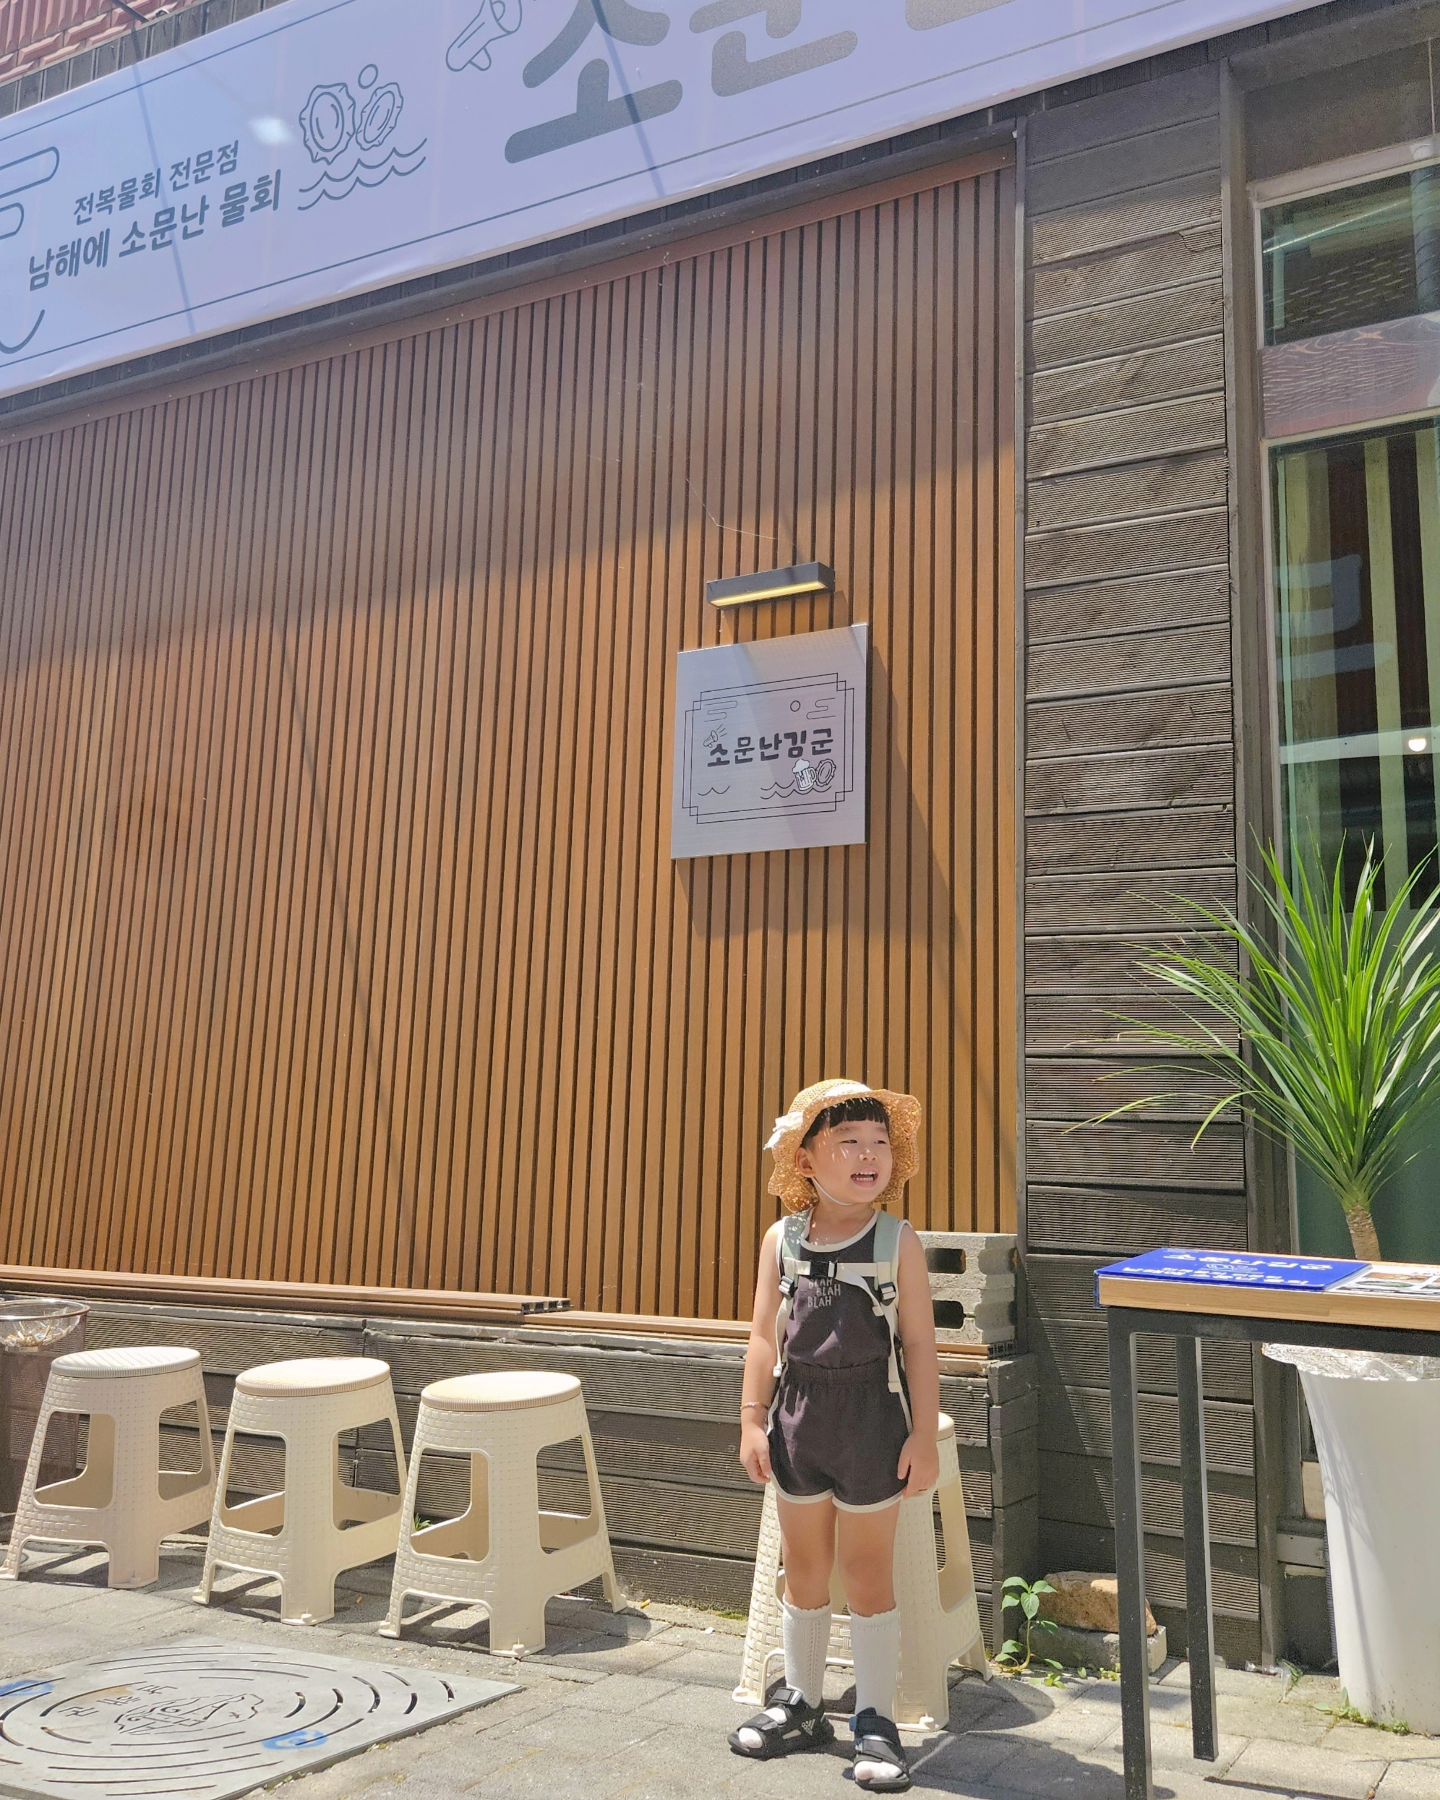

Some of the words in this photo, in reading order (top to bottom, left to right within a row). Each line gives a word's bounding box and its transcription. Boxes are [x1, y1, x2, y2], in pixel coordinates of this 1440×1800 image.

[73, 167, 162, 226] 전복물회
[169, 139, 239, 192] 전문점
[29, 228, 111, 291] 남해에
[118, 194, 210, 258] 소문난
[219, 168, 282, 228] 물회
[706, 728, 834, 767] 소문난김군
[807, 1296, 832, 1308] BLAH
[816, 1284, 841, 1297] BLAH
